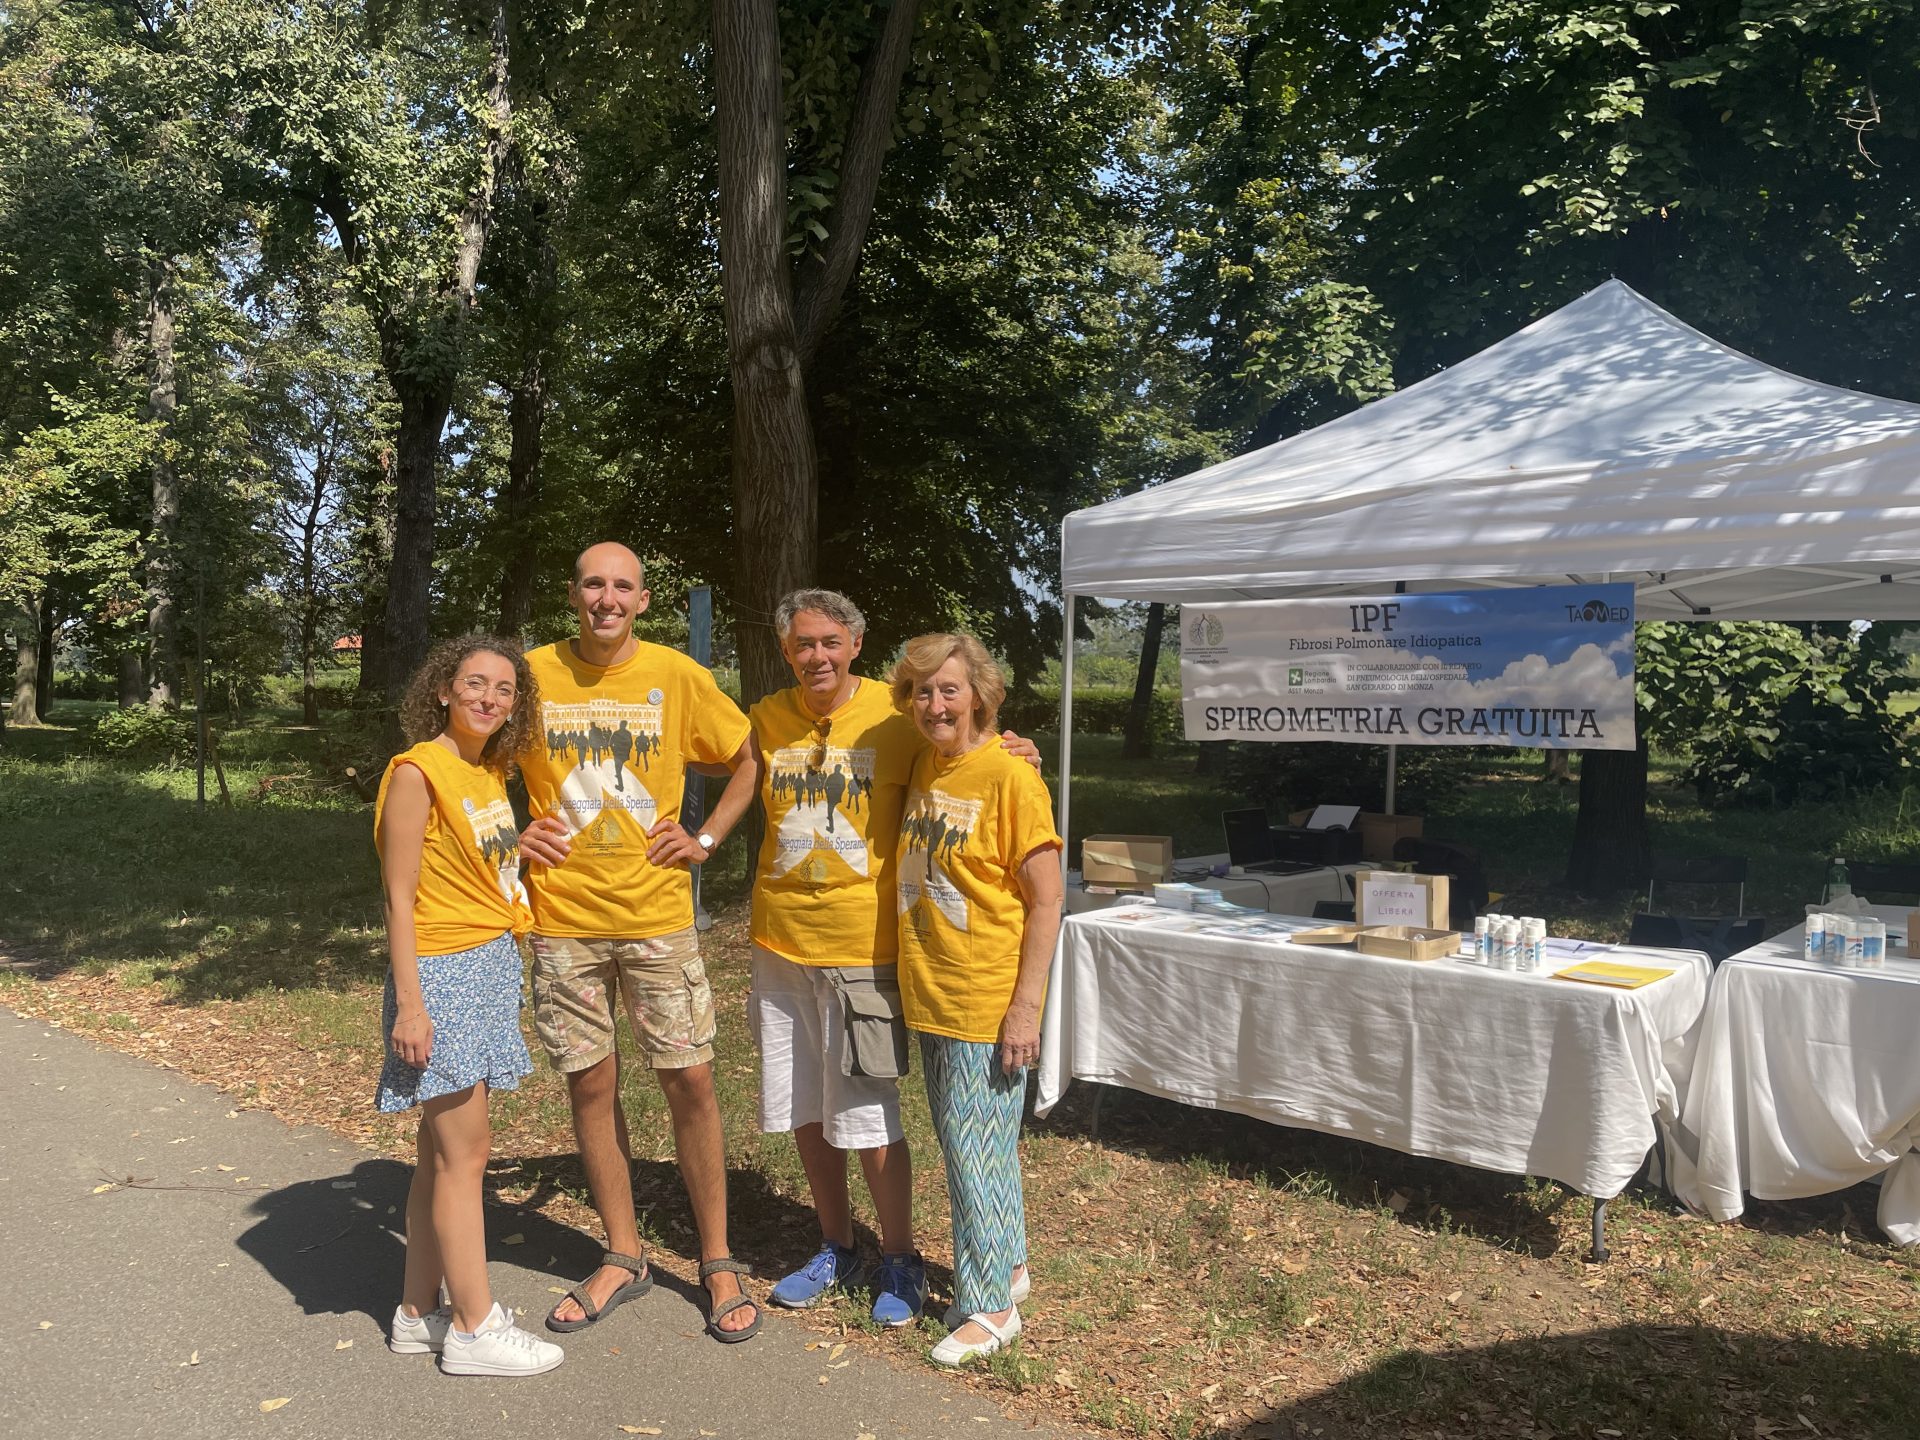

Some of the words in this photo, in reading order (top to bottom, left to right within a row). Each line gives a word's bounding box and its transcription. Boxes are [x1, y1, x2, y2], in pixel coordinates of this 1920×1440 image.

[1350, 603, 1400, 632] IPF
[1289, 637, 1333, 650] Fibrosi
[1336, 636, 1407, 649] Polmonare
[1410, 634, 1482, 650] Idiopatica
[1356, 663, 1421, 671] COLLABORAZIONE
[1422, 663, 1439, 671] CON
[1448, 662, 1482, 670] REPARTO
[1304, 670, 1330, 679] Regione
[1347, 674, 1355, 682] DI
[1356, 674, 1409, 682] PNEUMOLOGIA
[1303, 687, 1324, 695] Monza
[1346, 683, 1361, 691] SAN
[1361, 683, 1397, 691] GERARDO
[1397, 683, 1406, 691] DI
[1407, 683, 1434, 691] MONZA
[1205, 706, 1410, 735] SPIROMETRIA
[1417, 707, 1605, 738] GRATUITA
[1372, 889, 1415, 899] OFFERTA
